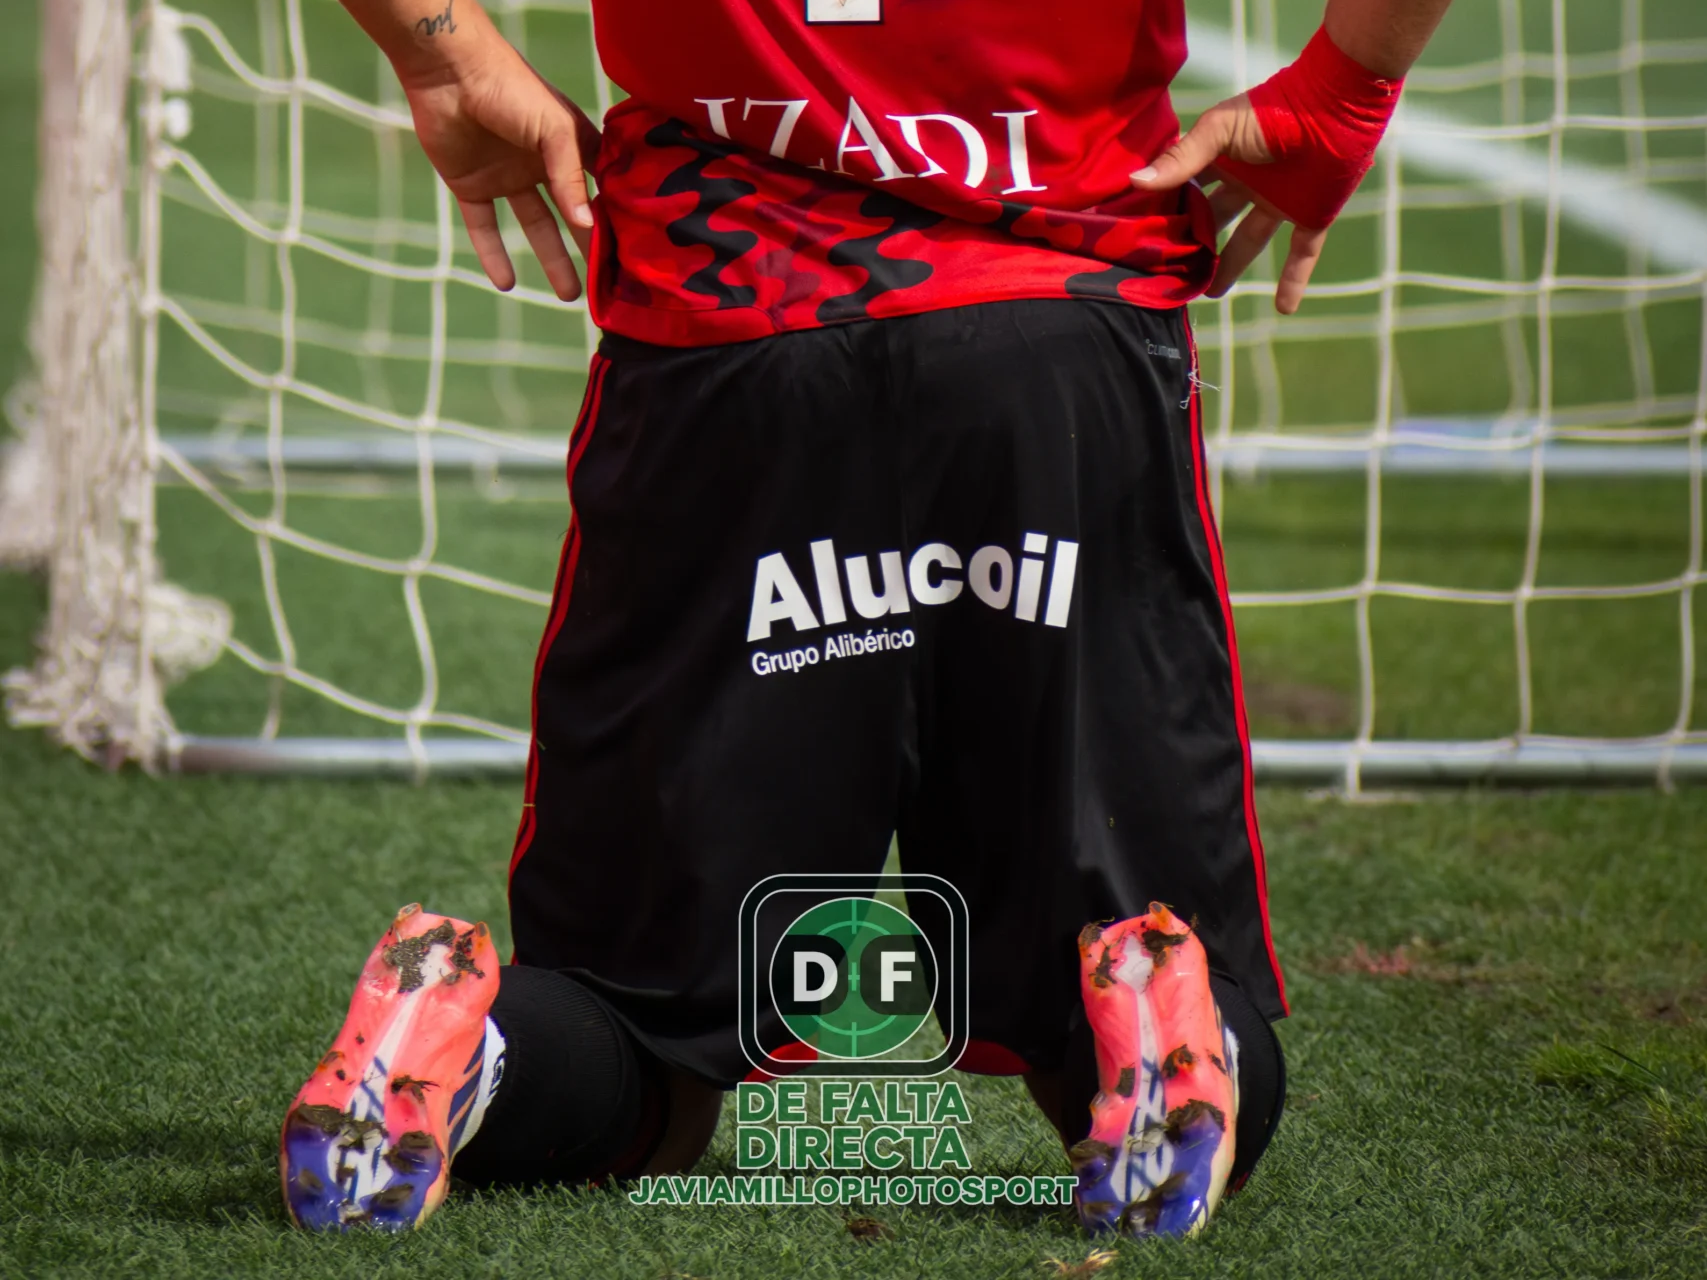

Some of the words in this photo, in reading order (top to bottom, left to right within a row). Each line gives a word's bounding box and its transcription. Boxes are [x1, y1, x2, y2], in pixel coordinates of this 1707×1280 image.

[746, 531, 1080, 643] Alucoil
[751, 645, 820, 676] Grupo
[824, 628, 916, 661] Alibérico
